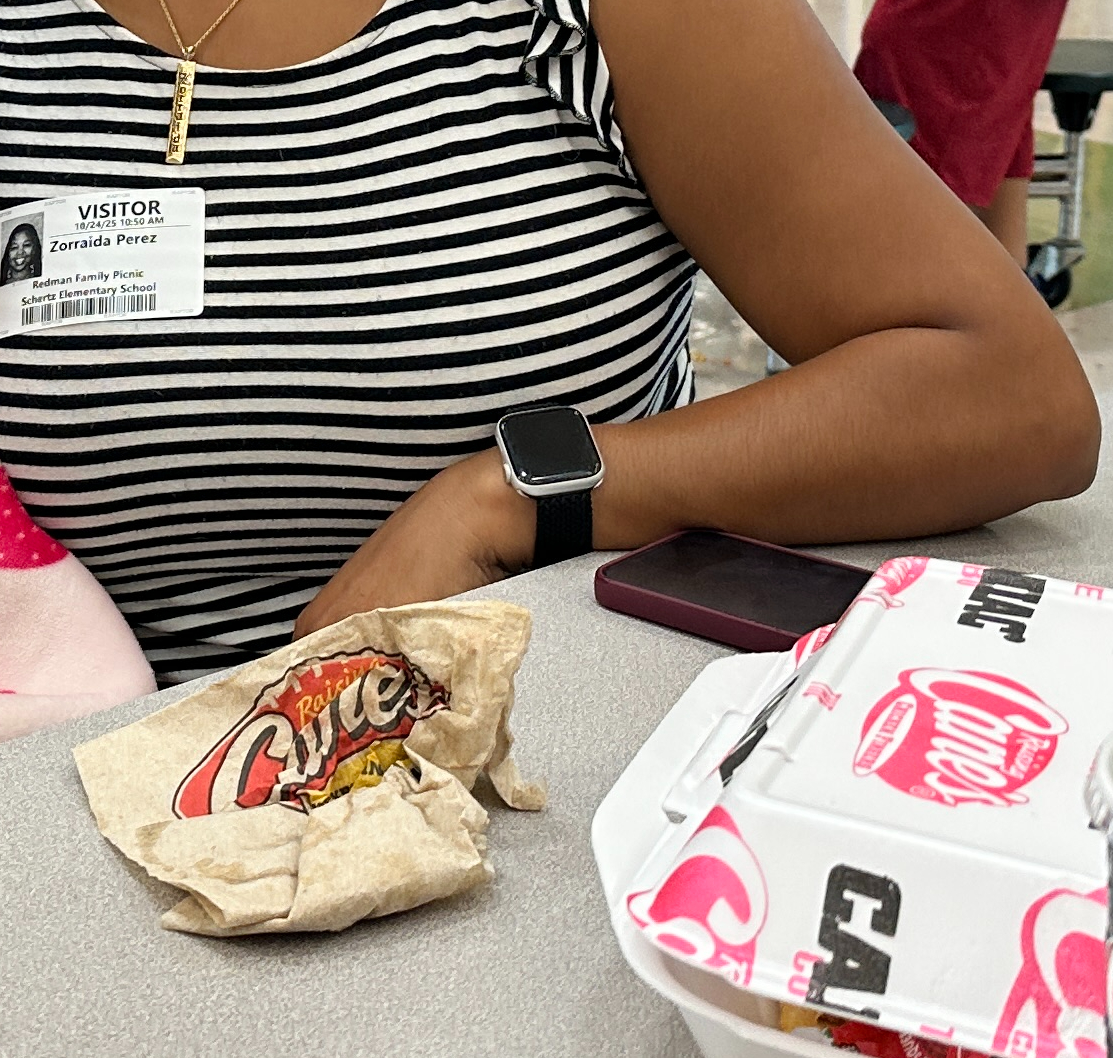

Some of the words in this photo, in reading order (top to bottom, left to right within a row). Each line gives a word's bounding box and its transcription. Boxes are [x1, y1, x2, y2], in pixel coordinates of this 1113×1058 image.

[78, 200, 162, 220] VISITOR
[74, 220, 117, 231] 10/24/25
[120, 218, 145, 227] 10:50
[50, 235, 111, 253] Zorraida
[116, 234, 158, 246] Perez
[32, 276, 72, 289] Redman
[75, 271, 109, 283] Family
[113, 269, 144, 280] Picnic
[21, 292, 56, 306] Schertz
[59, 286, 118, 299] Elementary
[120, 282, 156, 293] School
[909, 669, 1069, 808] Cane's
